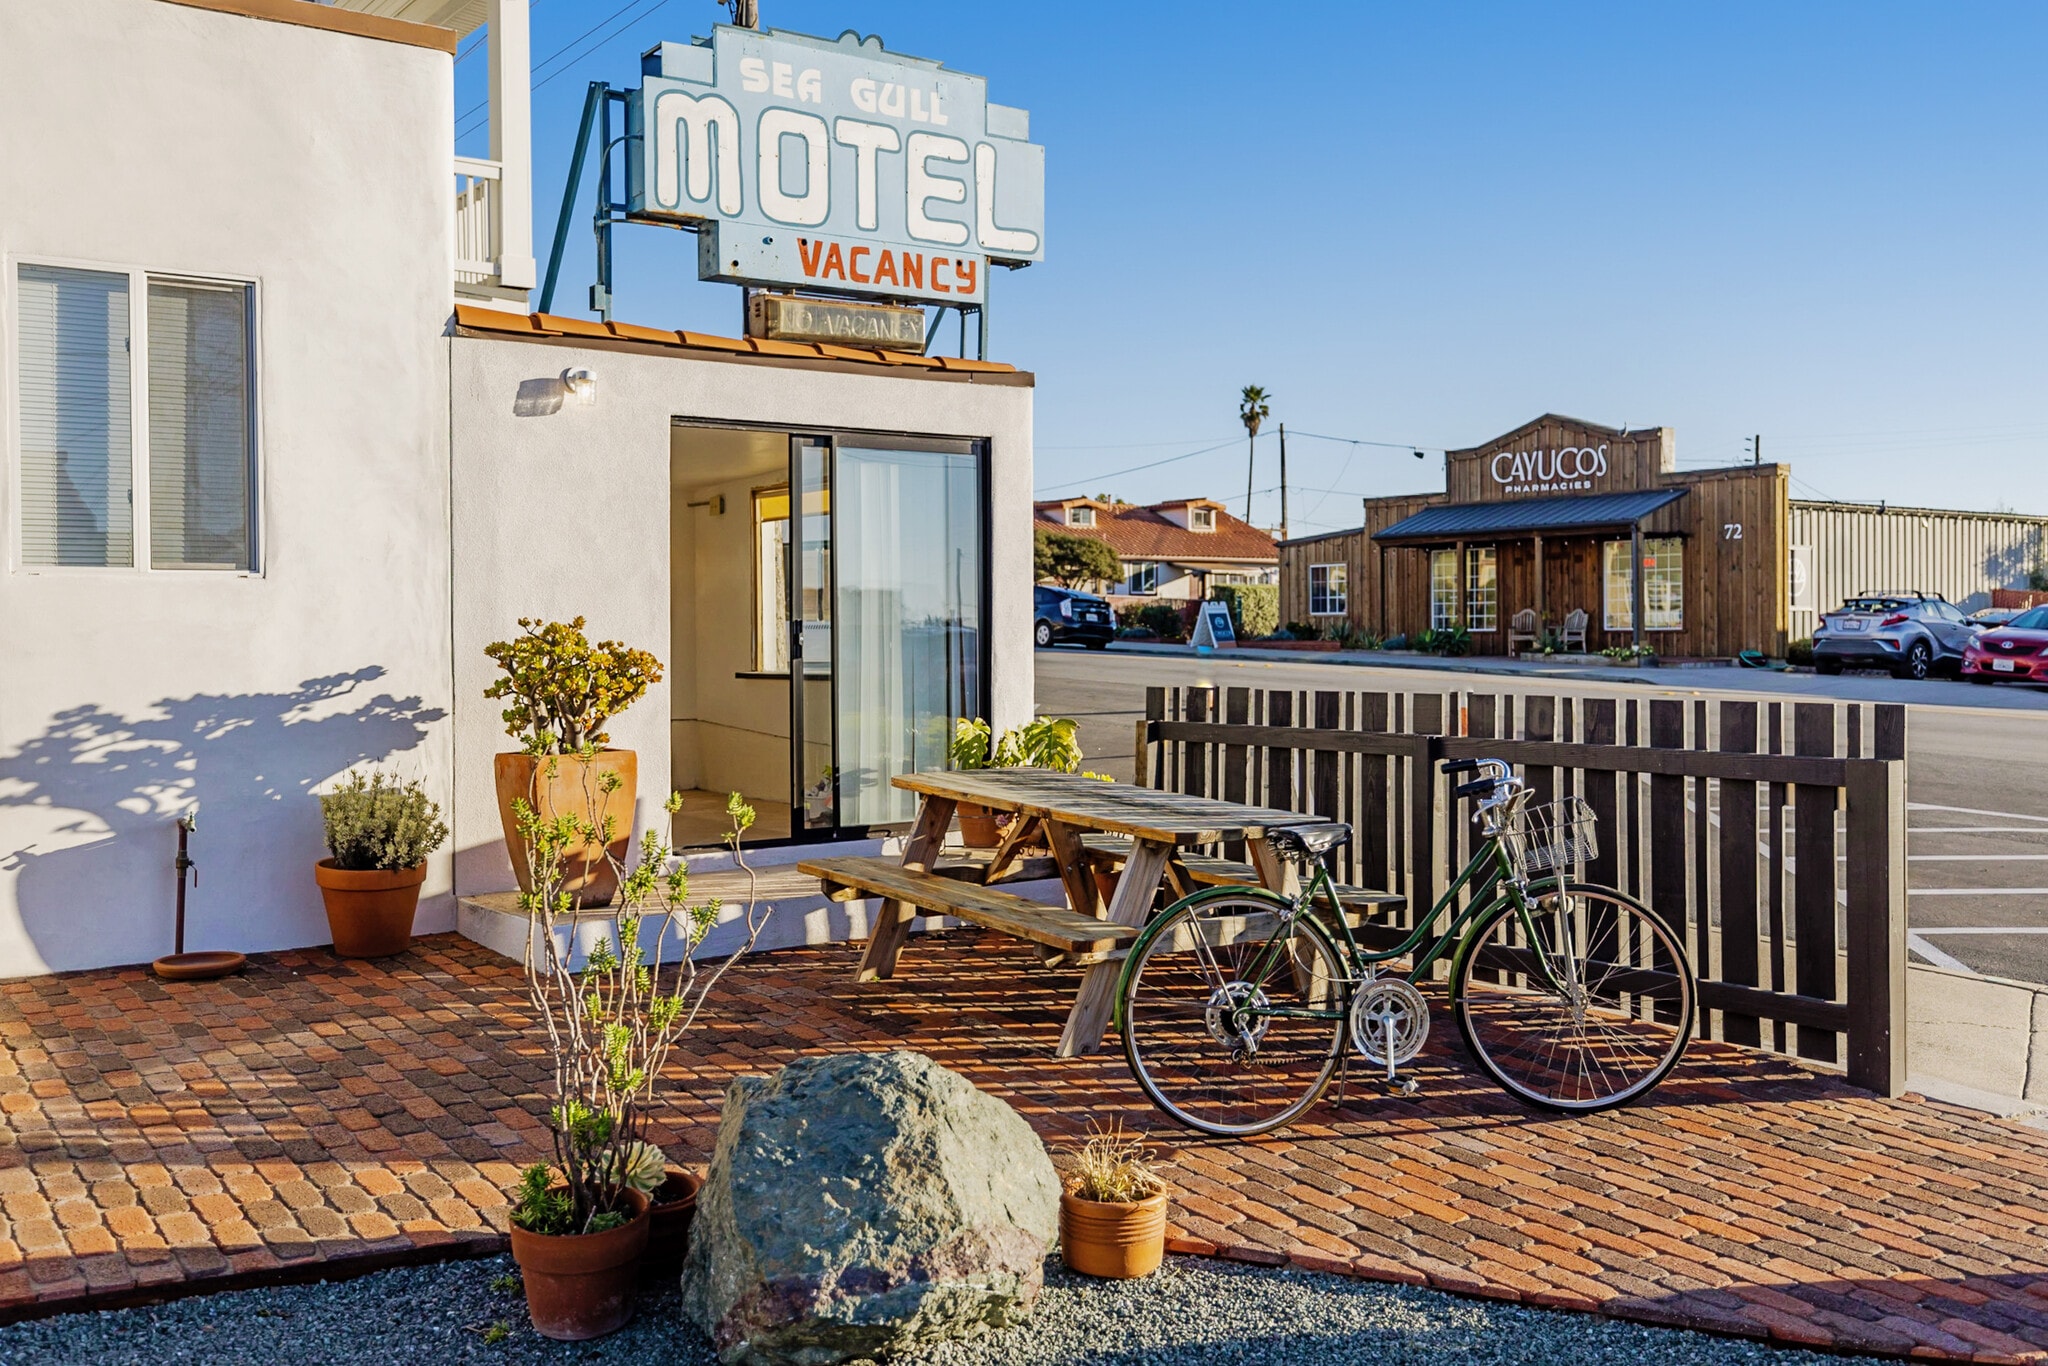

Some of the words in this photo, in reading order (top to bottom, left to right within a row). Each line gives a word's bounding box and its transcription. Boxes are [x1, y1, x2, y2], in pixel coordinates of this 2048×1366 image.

[739, 57, 822, 104] SEA
[851, 77, 949, 126] GULL
[655, 90, 1039, 254] MOTEL
[797, 237, 977, 294] VACANCY
[780, 307, 813, 332] NO
[823, 311, 922, 341] VACANCY
[1491, 444, 1607, 483] CAYUCOS
[1505, 480, 1592, 493] PHARMACIES
[1724, 523, 1743, 540] 72
